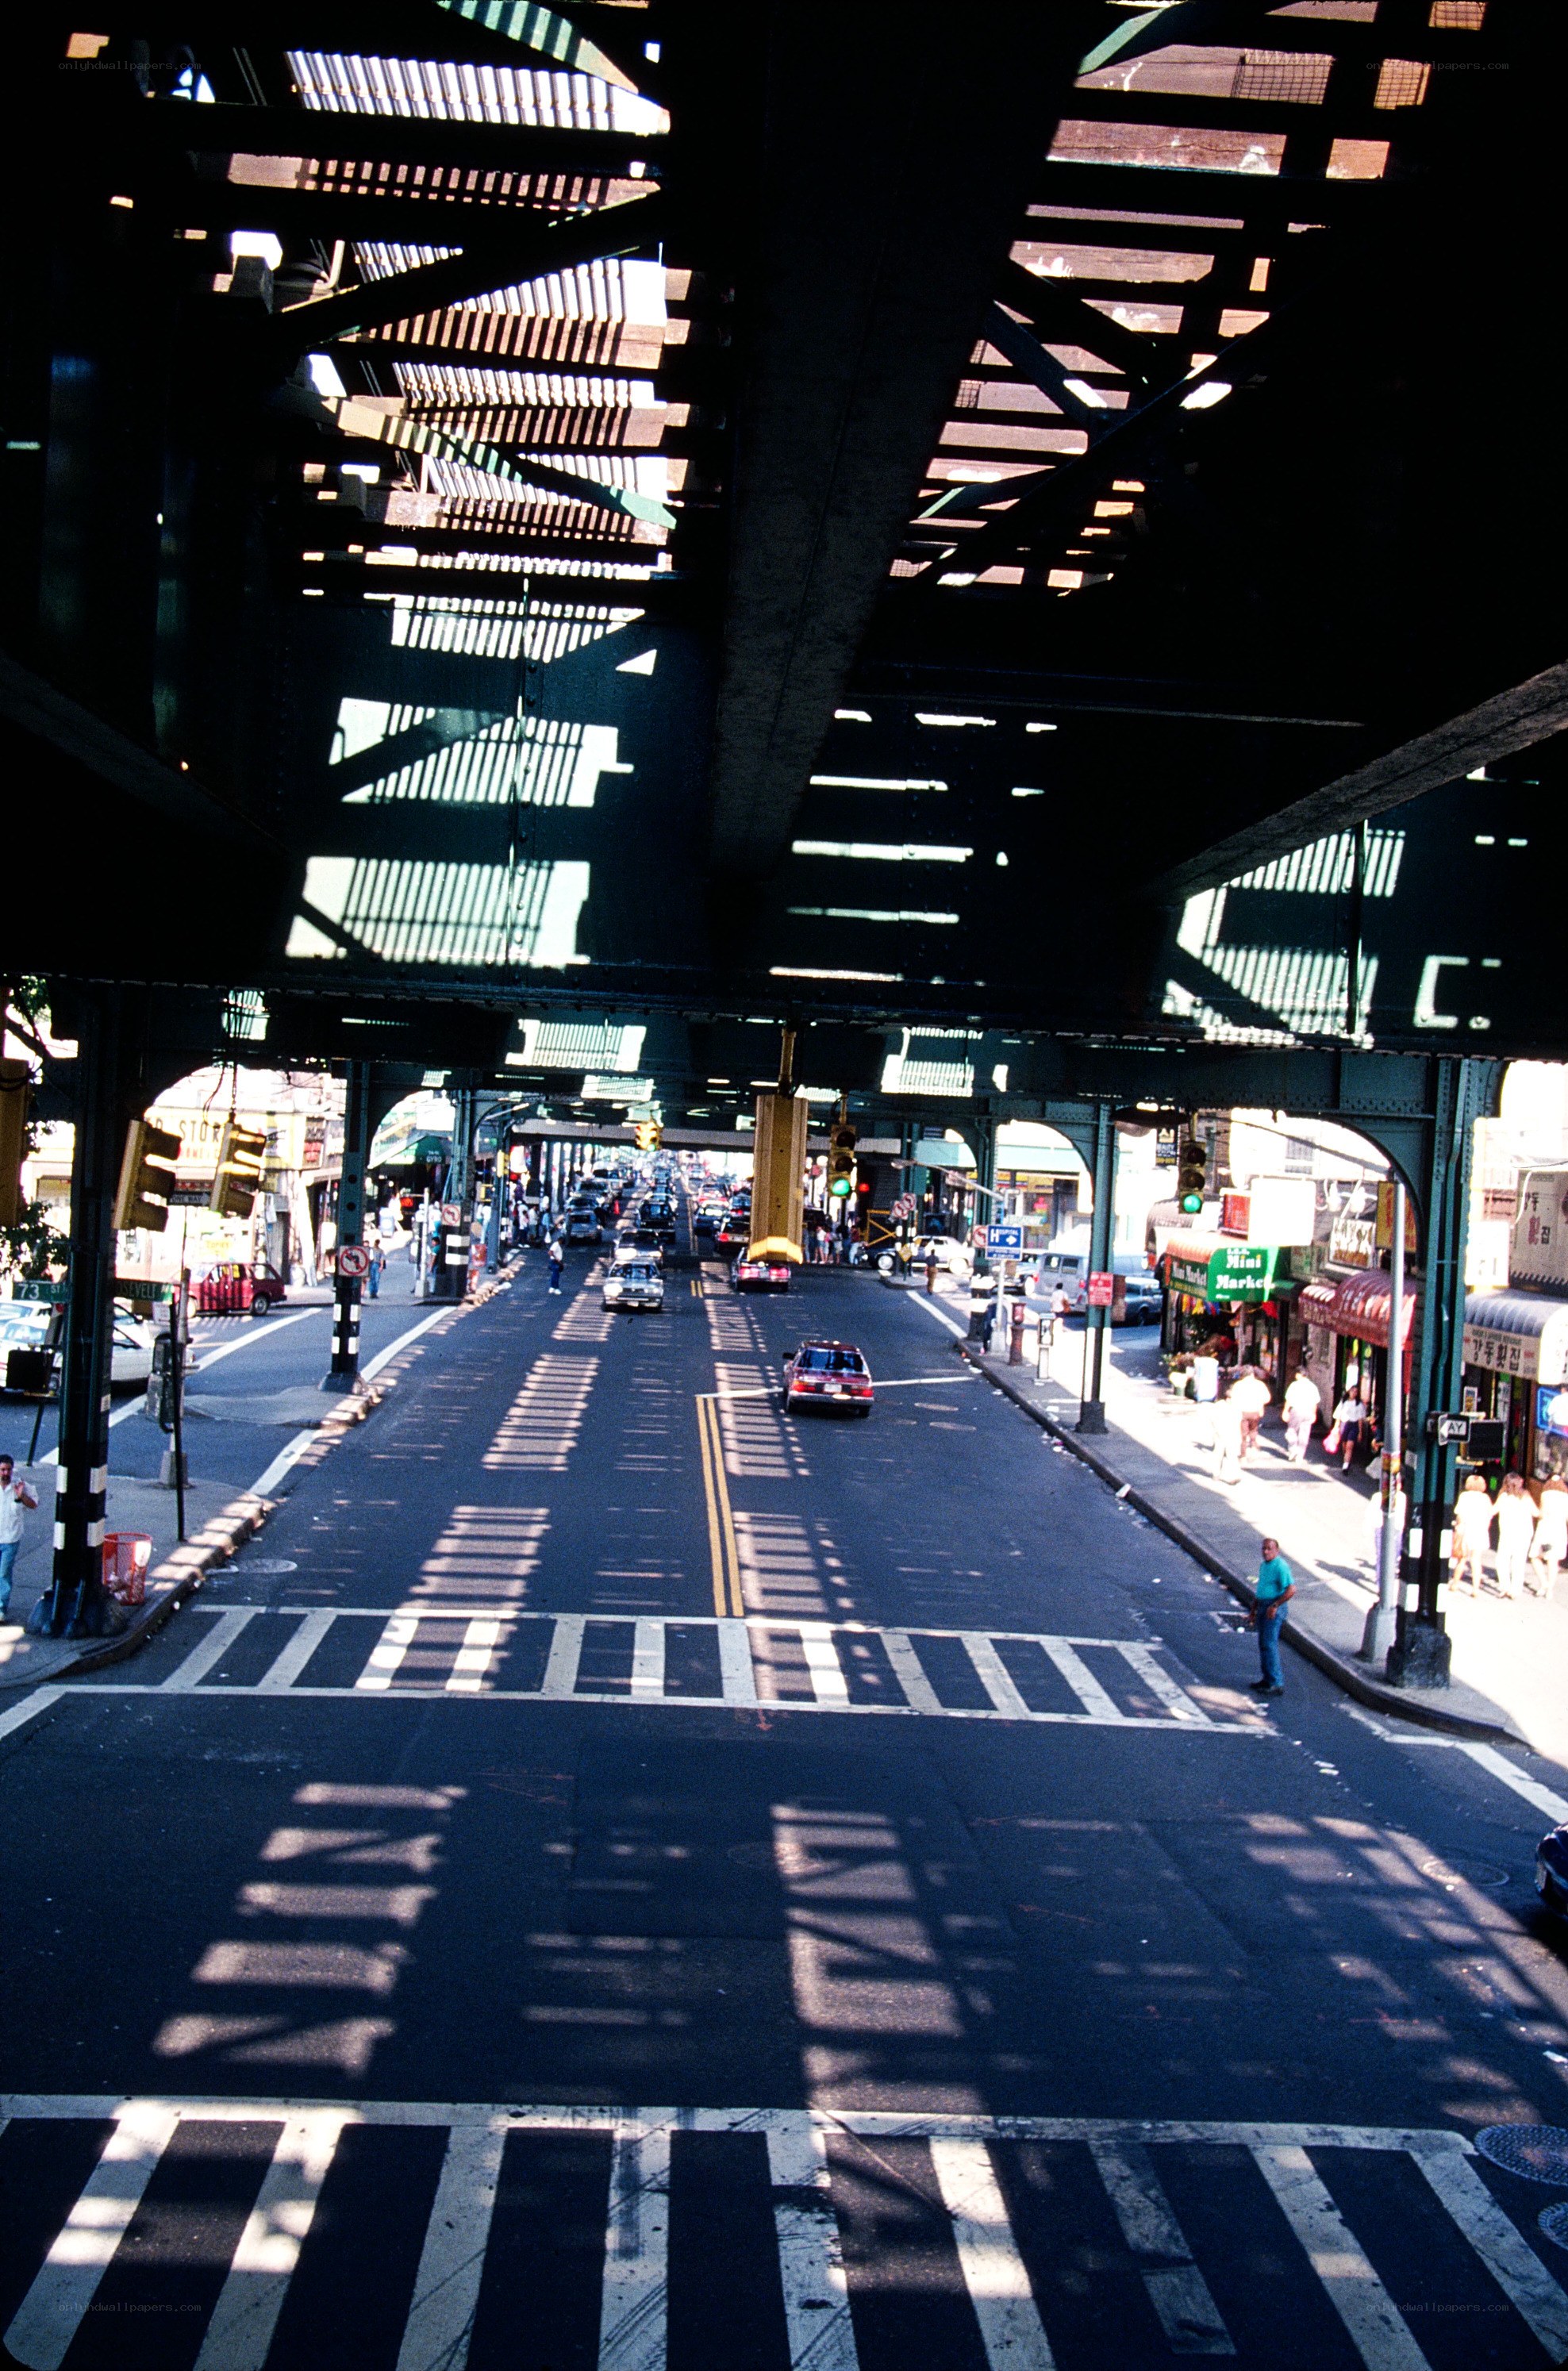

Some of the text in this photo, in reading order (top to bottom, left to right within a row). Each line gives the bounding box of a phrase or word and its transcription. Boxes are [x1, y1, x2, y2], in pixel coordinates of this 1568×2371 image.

[179, 1120, 219, 1143] STOR
[1226, 1255, 1261, 1268] Mini
[18, 1283, 40, 1300] 73
[1448, 1422, 1463, 1431] AY
